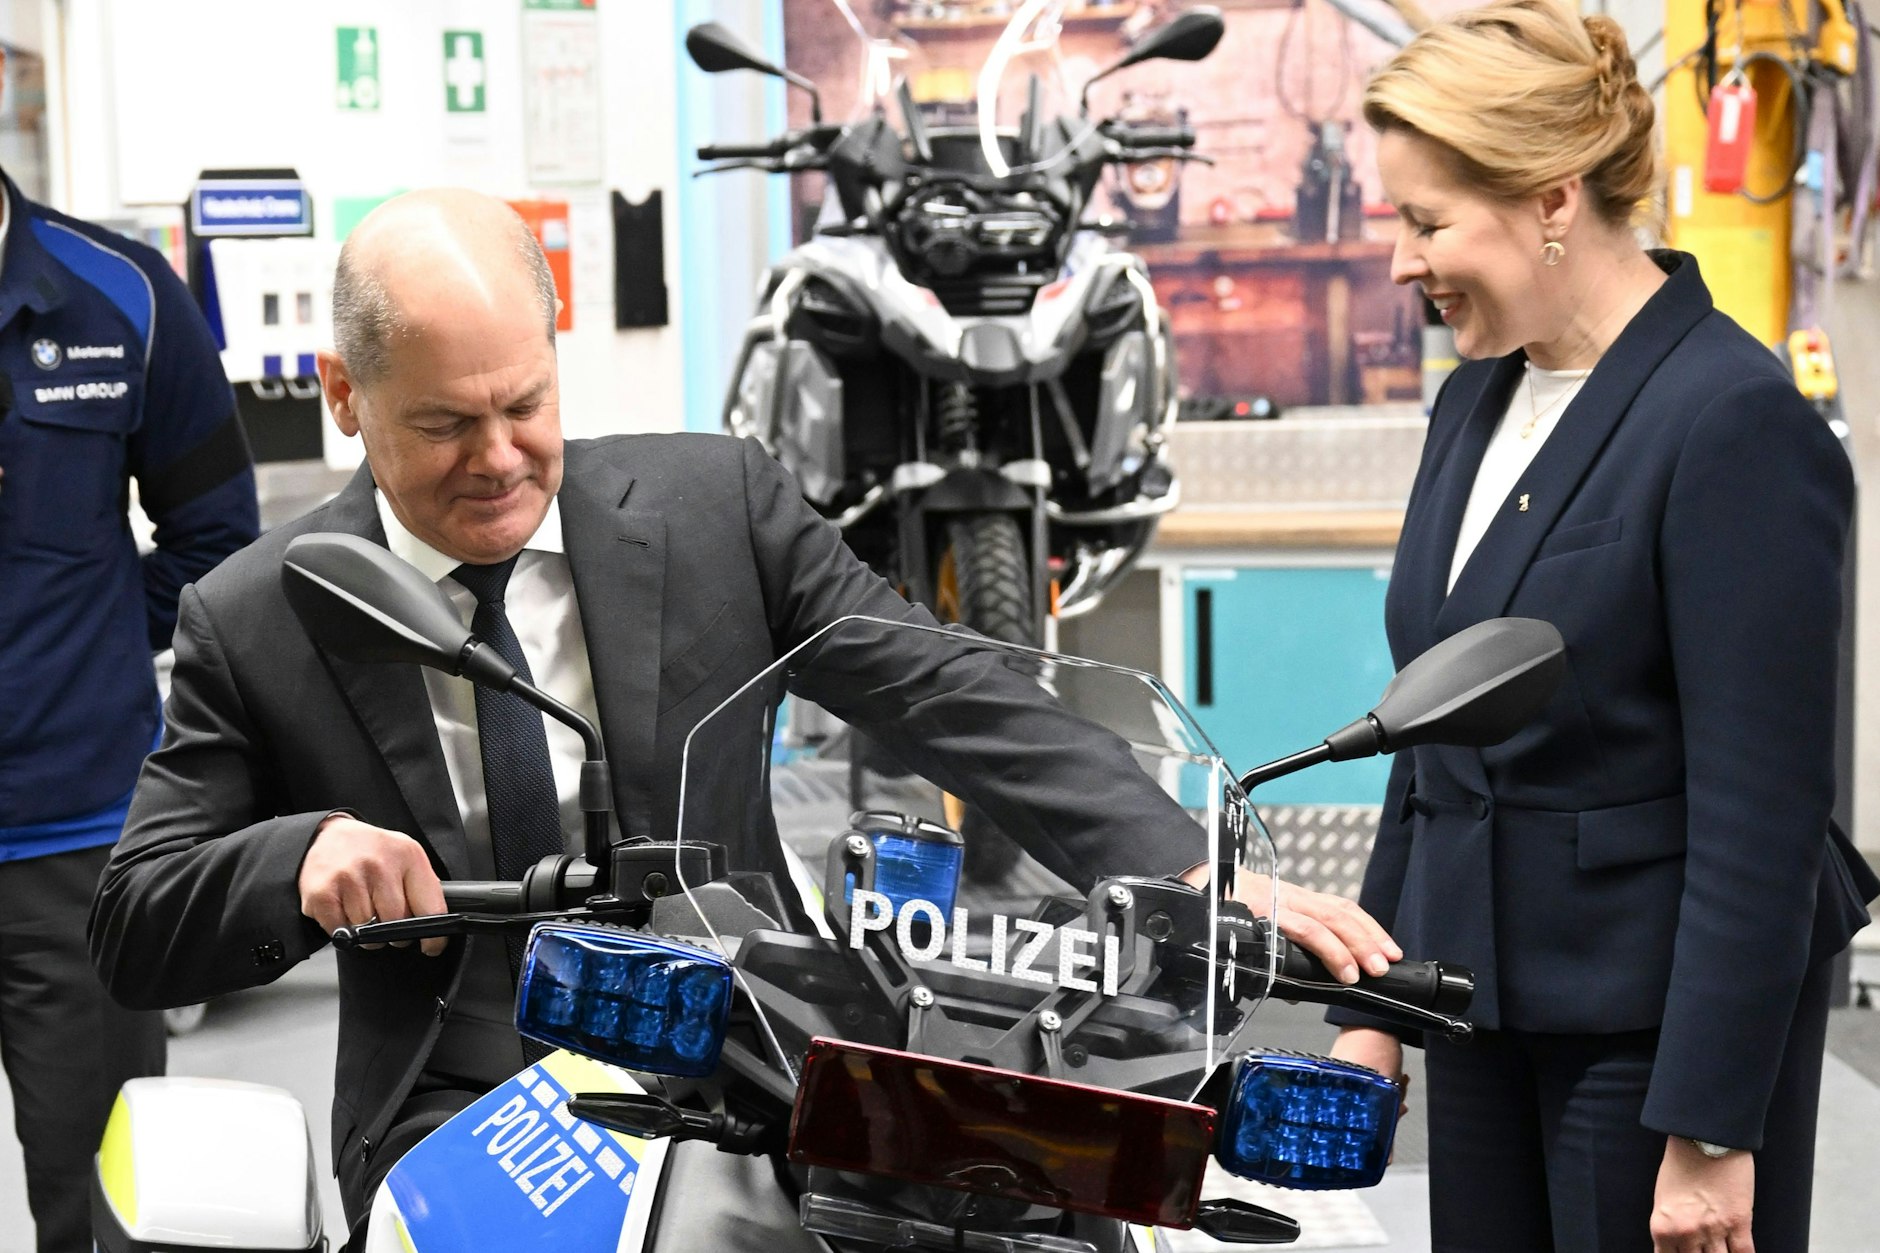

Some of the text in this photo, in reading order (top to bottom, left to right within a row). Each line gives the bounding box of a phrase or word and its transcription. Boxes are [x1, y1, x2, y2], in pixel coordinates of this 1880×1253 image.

[66, 345, 124, 359] Motorrad
[35, 382, 128, 402] BMW GROUP
[849, 887, 1119, 996] POLIZEI
[471, 1094, 595, 1218] POLIZEI
